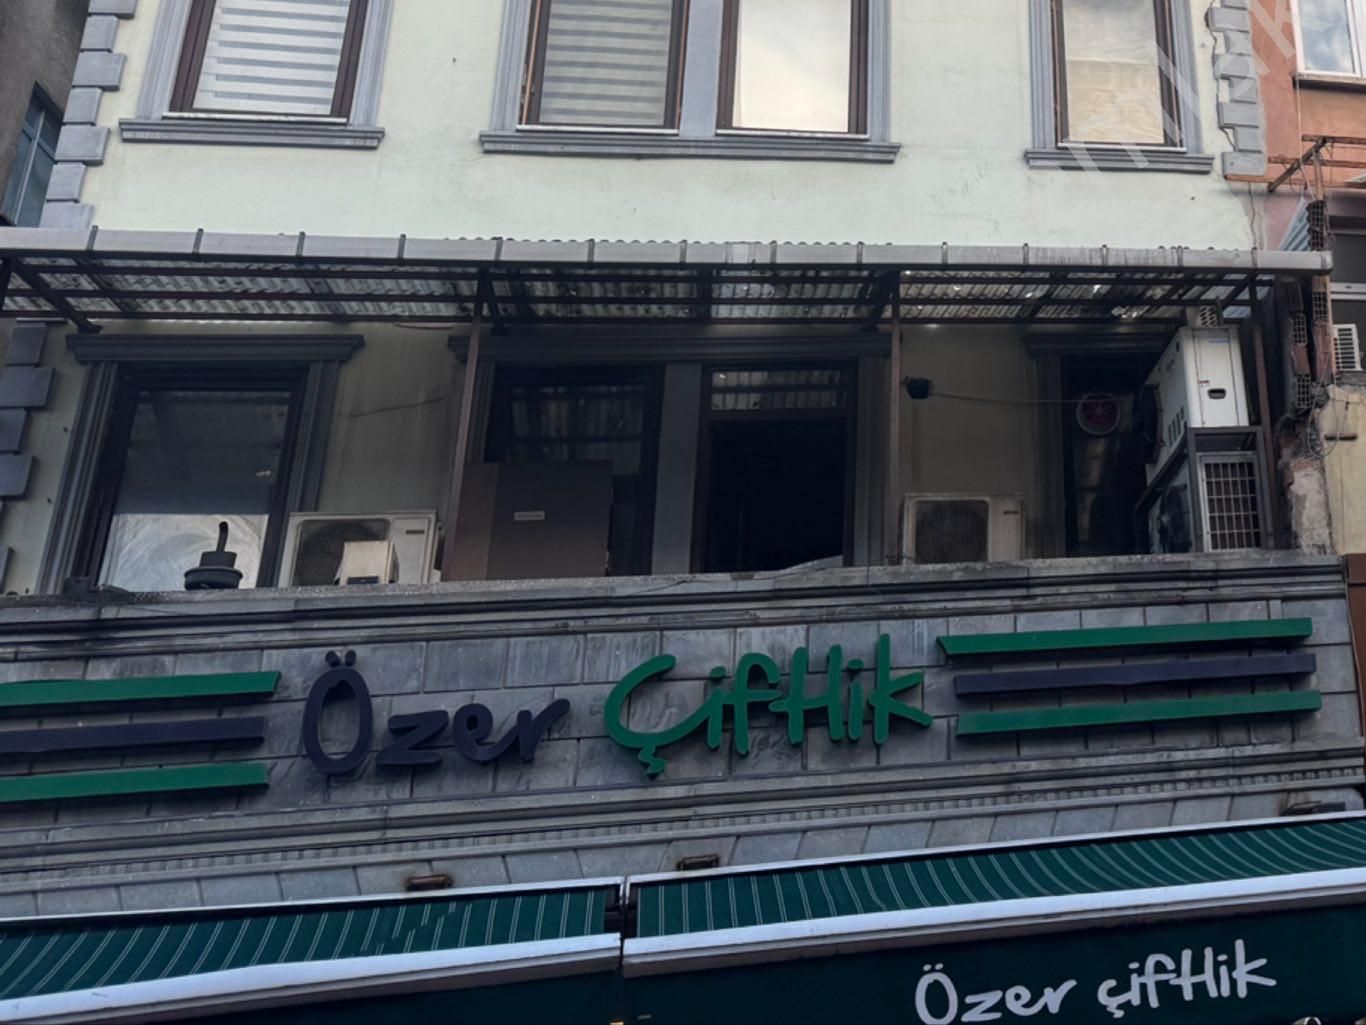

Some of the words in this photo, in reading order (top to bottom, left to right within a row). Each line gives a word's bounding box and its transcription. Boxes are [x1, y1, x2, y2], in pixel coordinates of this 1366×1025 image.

[303, 650, 571, 775] Özer
[604, 633, 935, 778] Çiftlik
[915, 963, 1077, 1025] Özer
